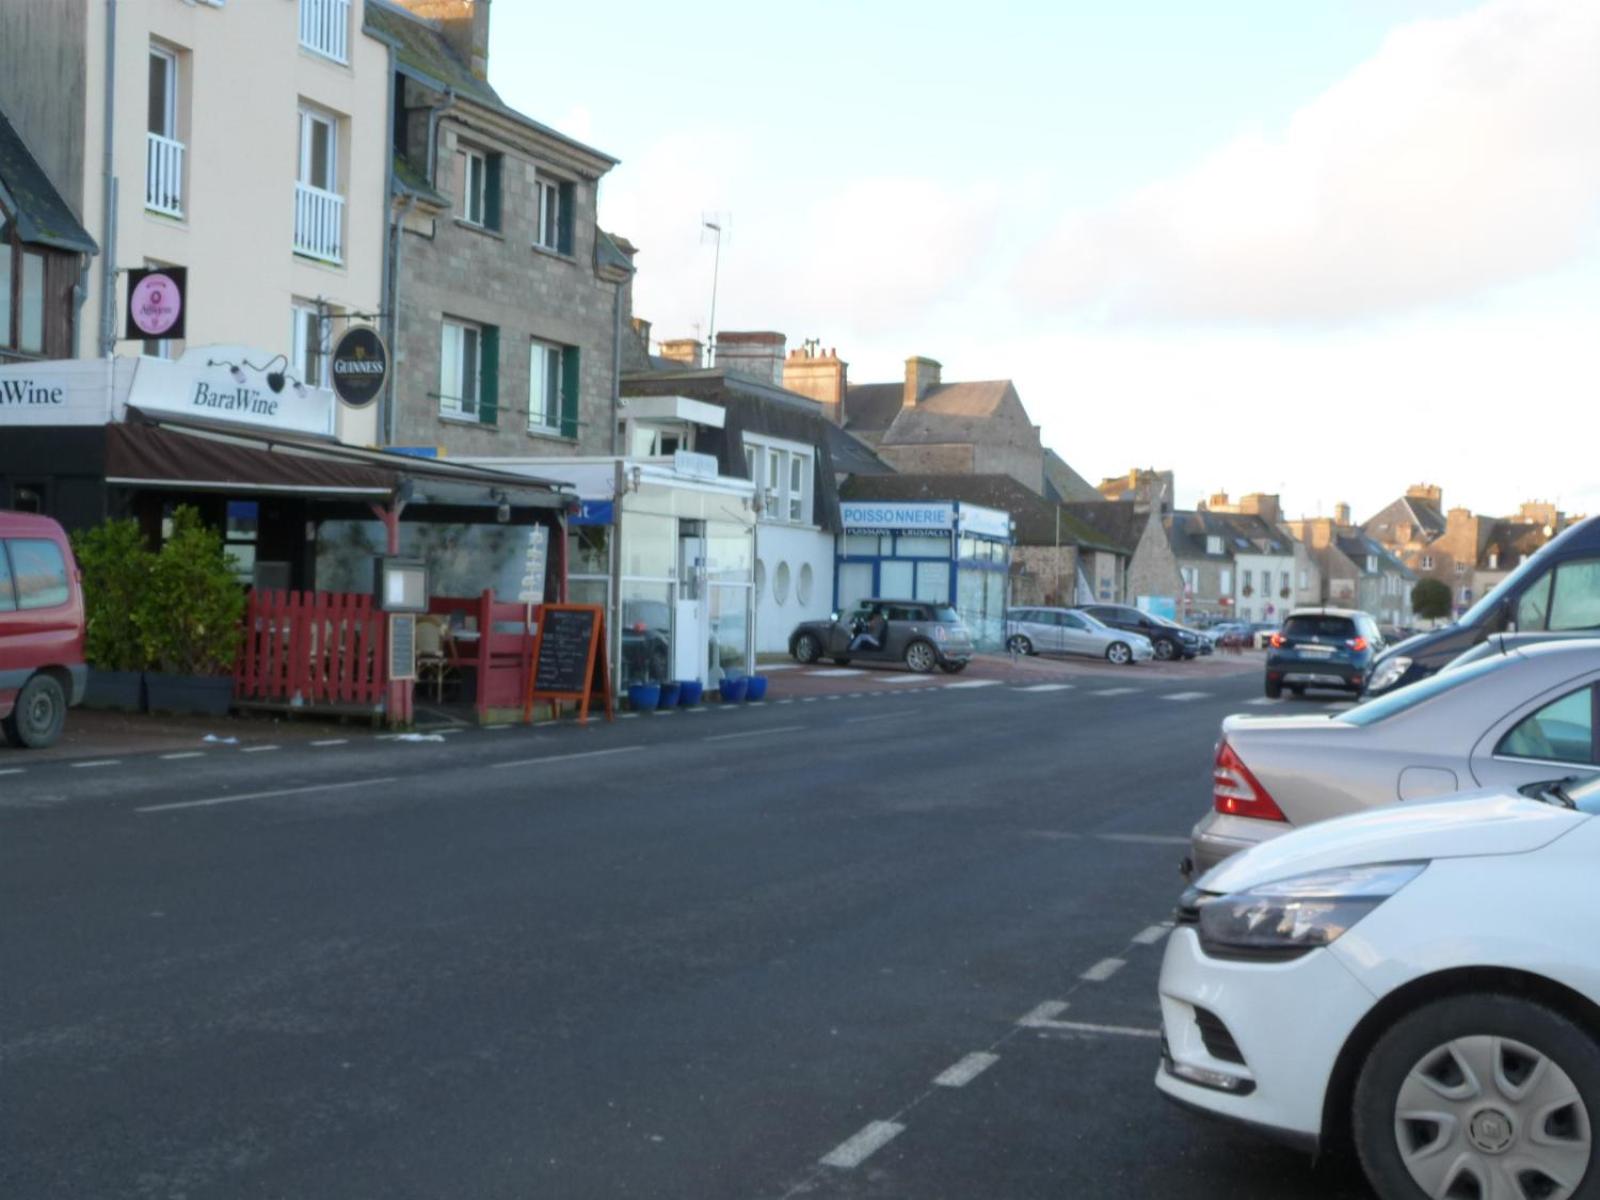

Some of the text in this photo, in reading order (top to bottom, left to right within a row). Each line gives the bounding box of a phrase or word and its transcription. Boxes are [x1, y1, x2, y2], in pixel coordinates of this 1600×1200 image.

[334, 359, 384, 374] GUINNESS
[0, 380, 63, 404] Wine
[193, 381, 279, 416] BaraWine
[844, 508, 945, 523] POISSONNERIE
